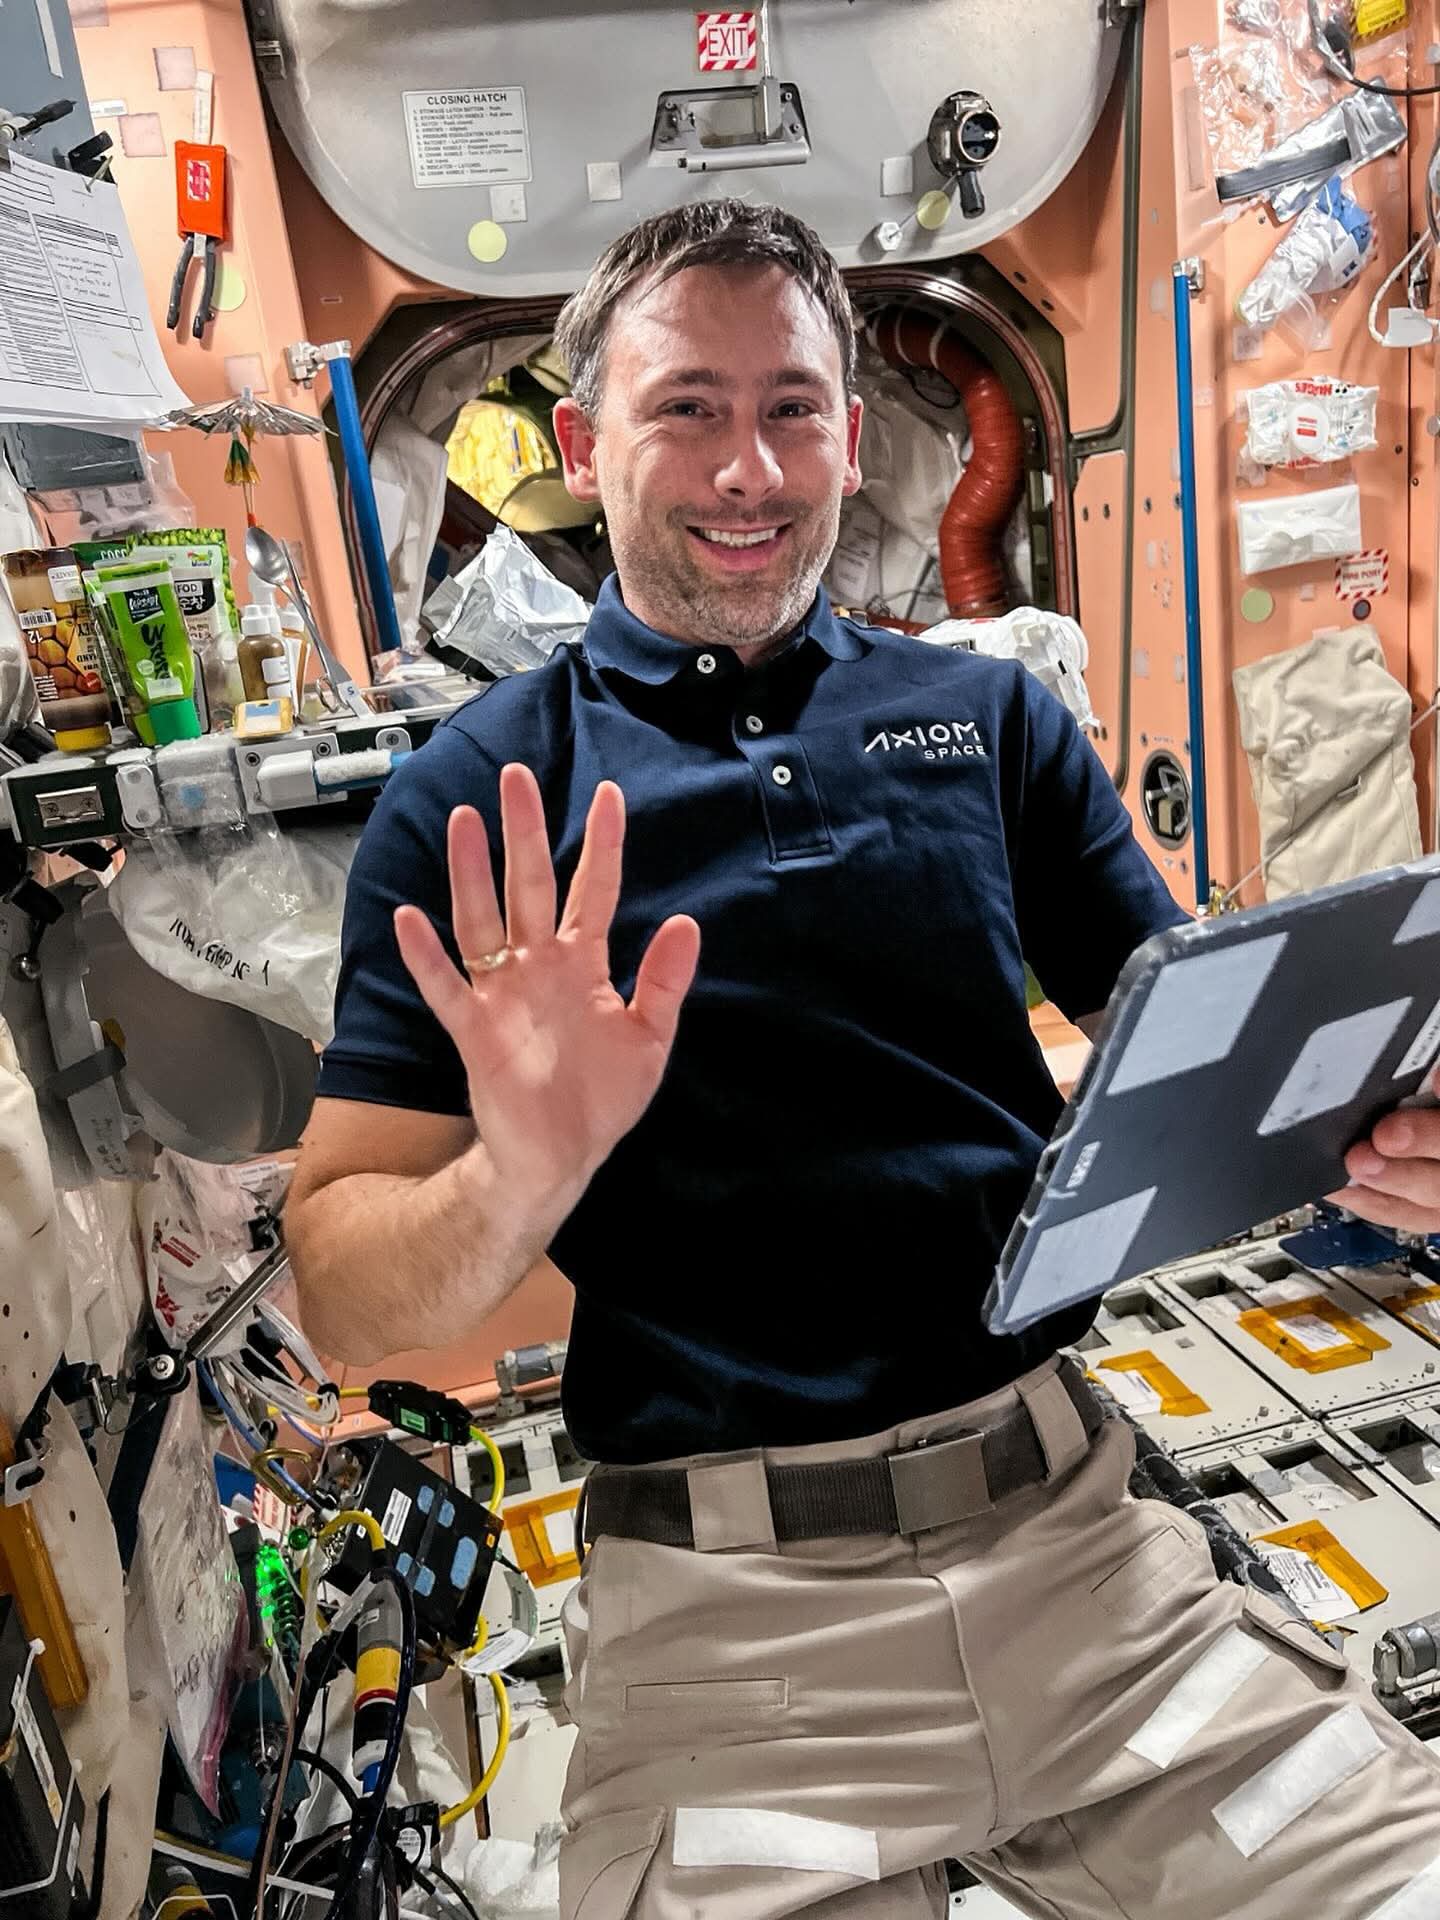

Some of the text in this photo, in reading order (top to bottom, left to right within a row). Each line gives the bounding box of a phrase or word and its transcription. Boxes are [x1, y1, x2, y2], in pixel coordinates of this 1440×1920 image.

[708, 27, 747, 57] EXIT
[426, 93, 507, 105] CLOSING HATCH
[28, 631, 43, 644] 12
[864, 721, 981, 754] AXIOM
[923, 744, 986, 760] SPACE
